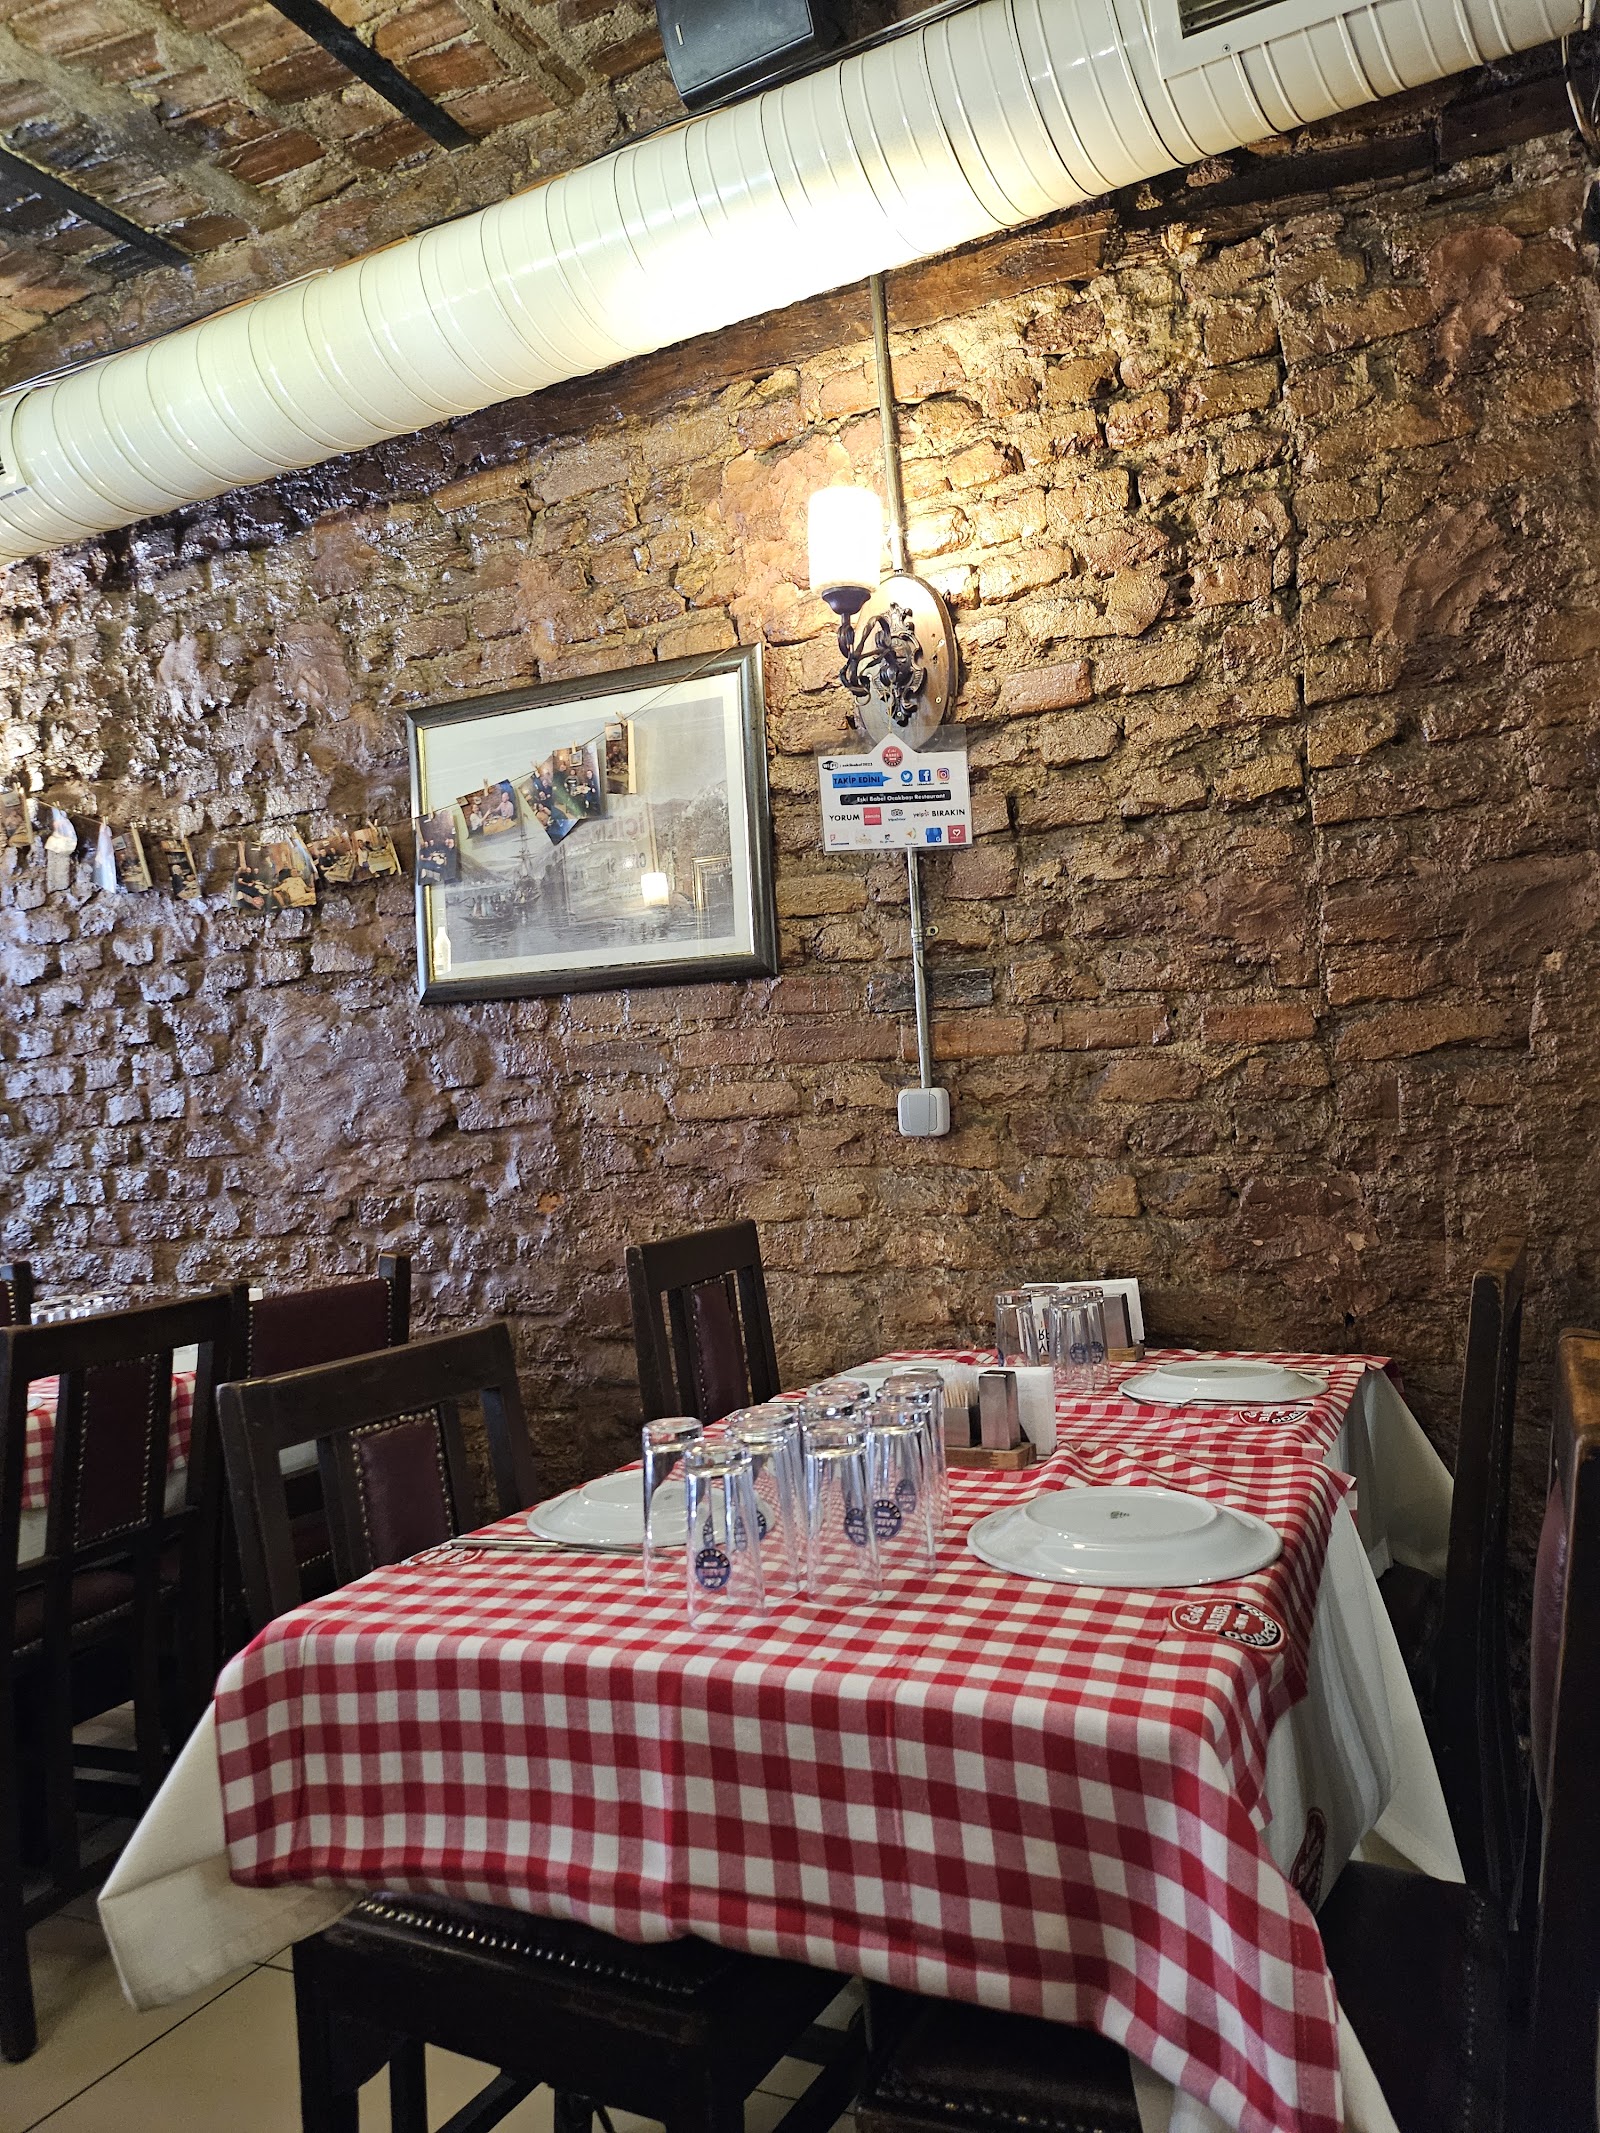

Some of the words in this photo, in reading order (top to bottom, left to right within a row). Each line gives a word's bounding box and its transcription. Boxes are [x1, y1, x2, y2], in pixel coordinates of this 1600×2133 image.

[833, 776, 857, 785] TAKİP
[931, 809, 966, 817] BIRAKIN
[1203, 1605, 1232, 1632] BABEL
